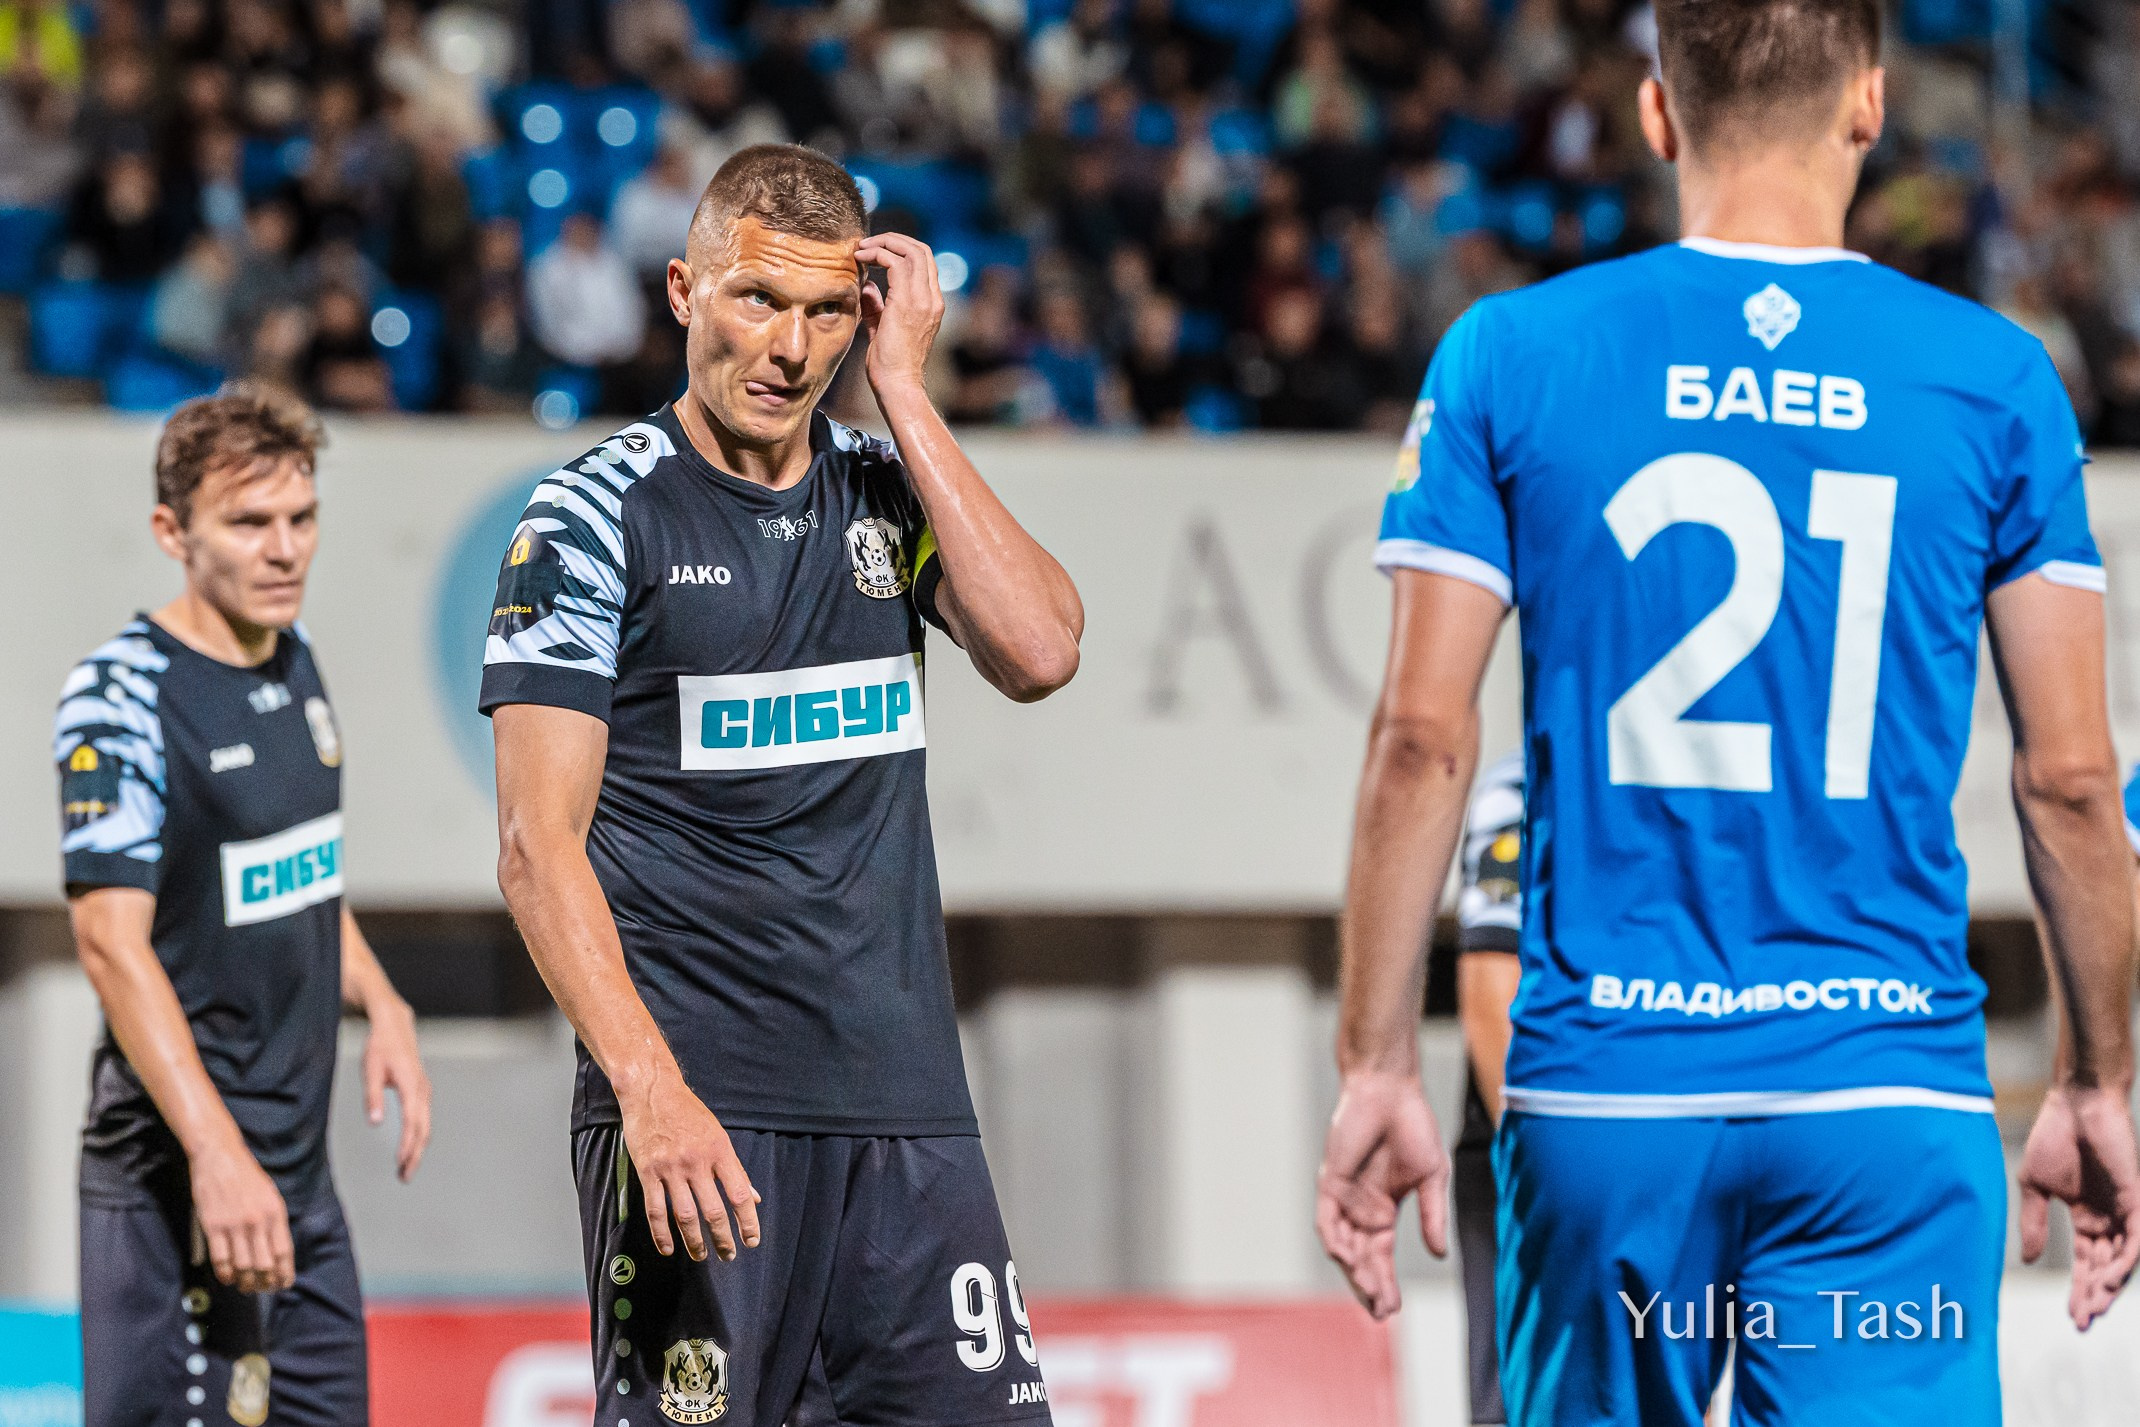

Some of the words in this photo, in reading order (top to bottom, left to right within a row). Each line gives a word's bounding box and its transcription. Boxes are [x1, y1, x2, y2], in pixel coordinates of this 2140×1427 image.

[1666, 364, 1868, 431] БАЕВ
[757, 509, 818, 541] 1961
[668, 565, 732, 585] JAKO
[859, 581, 908, 597] ТЮМЕНЬ
[875, 574, 889, 583] ФК
[1602, 452, 1898, 799] 21
[701, 680, 911, 749] СИБУР
[240, 836, 342, 904] СИБУ
[1590, 974, 1934, 1018] ВЛАДИВОСТОК
[664, 1404, 722, 1423] ТЮМЕНЬ
[685, 1399, 701, 1408] ФК
